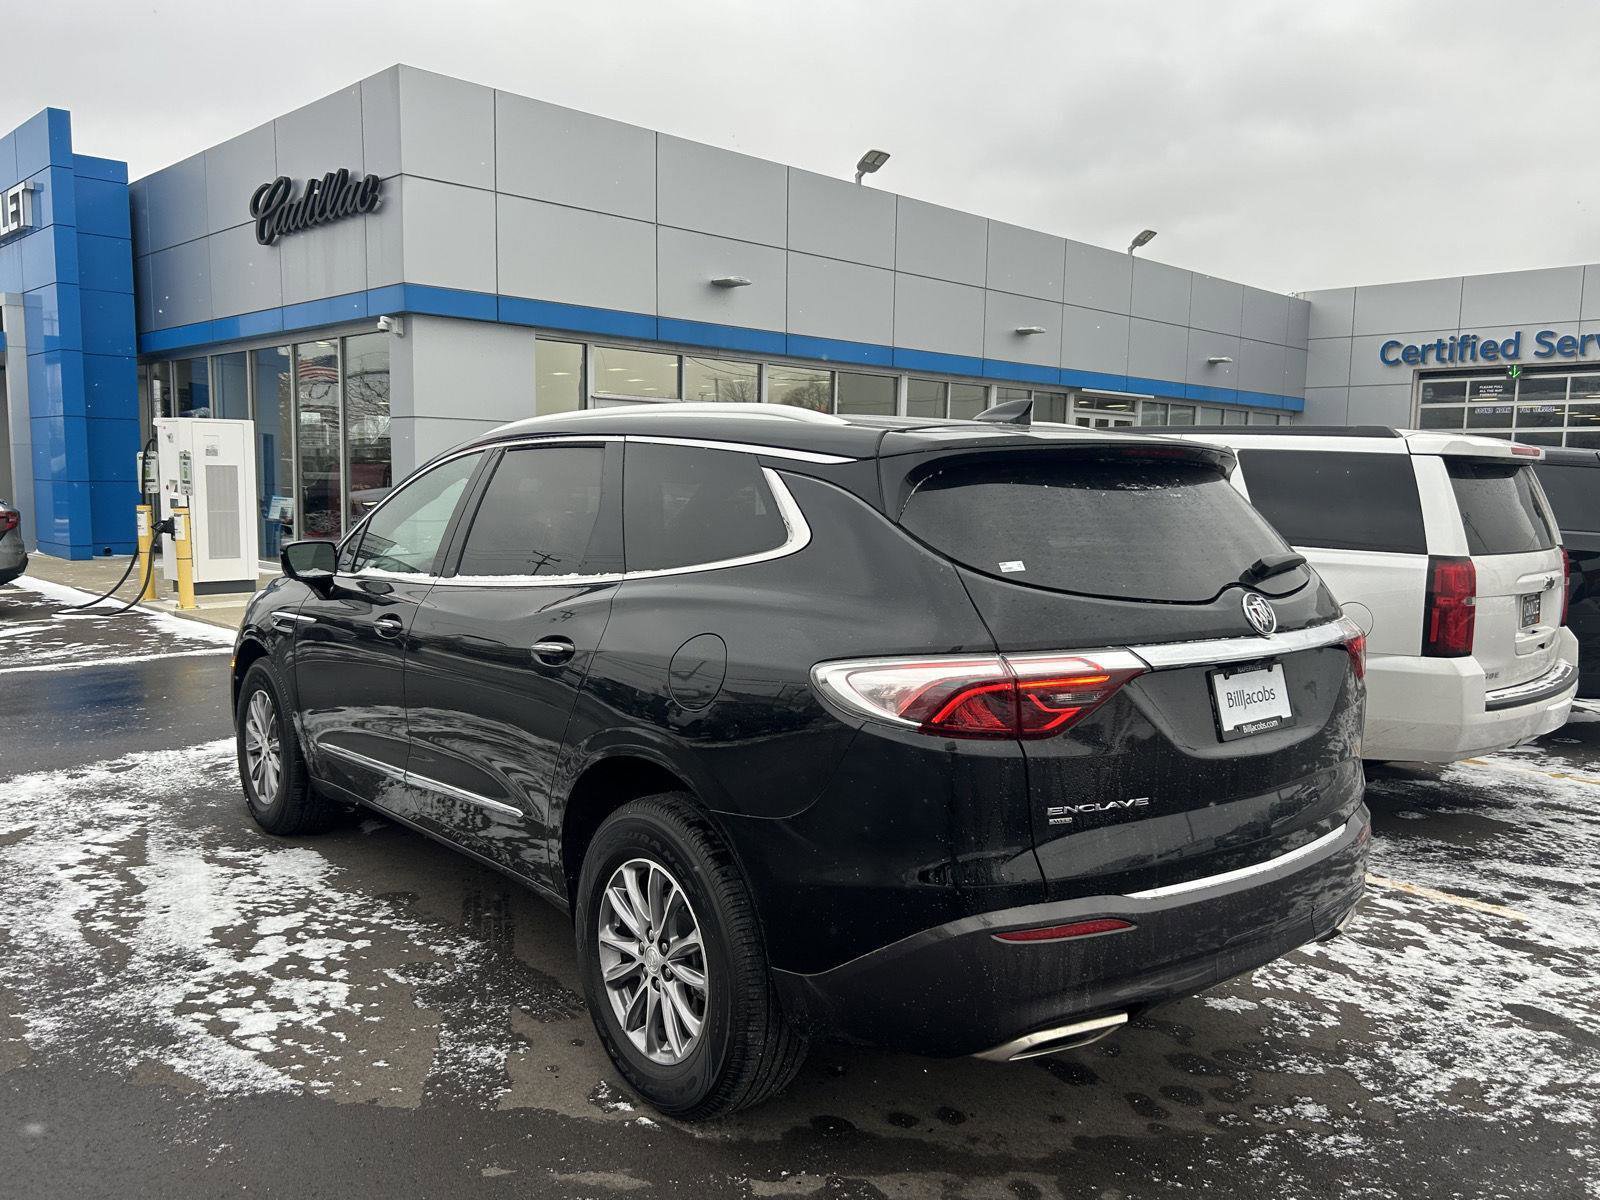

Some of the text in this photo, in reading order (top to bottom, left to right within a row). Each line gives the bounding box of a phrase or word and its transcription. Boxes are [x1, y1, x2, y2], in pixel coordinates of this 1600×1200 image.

[250, 168, 380, 246] Cadillac
[1379, 330, 1600, 367] Certified Ser
[1226, 686, 1276, 709] BillJacobs
[1047, 797, 1150, 816] ENCLAVE
